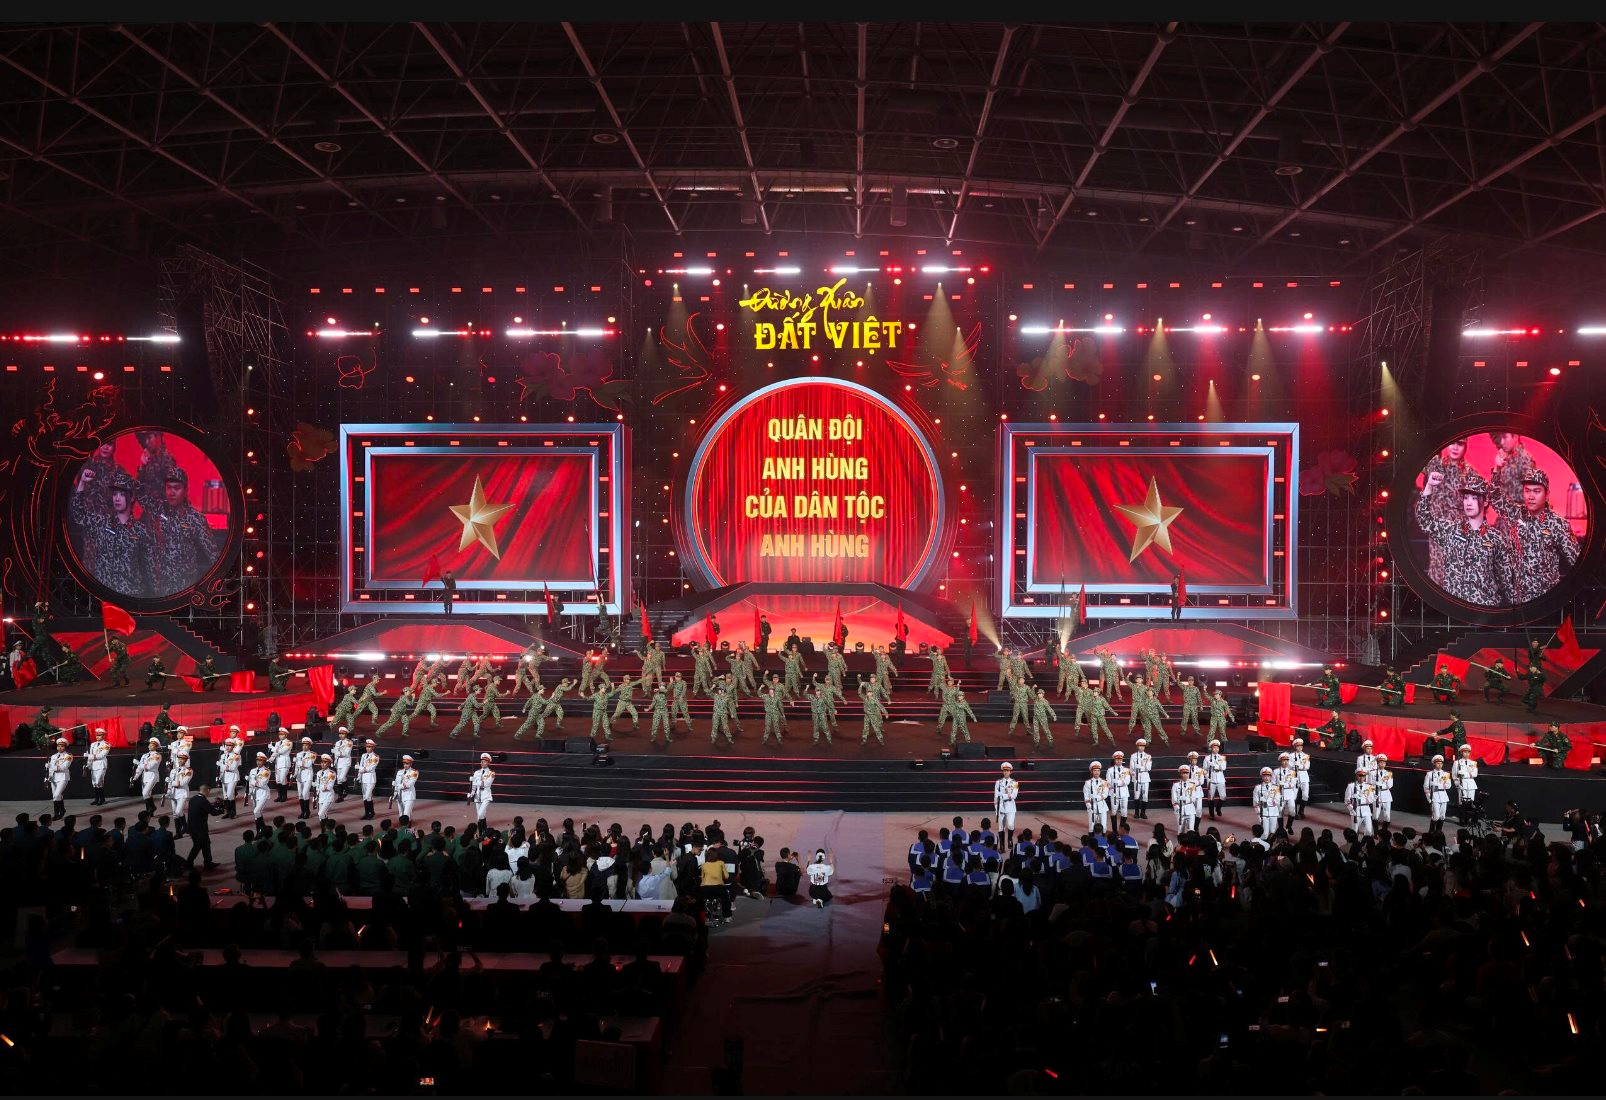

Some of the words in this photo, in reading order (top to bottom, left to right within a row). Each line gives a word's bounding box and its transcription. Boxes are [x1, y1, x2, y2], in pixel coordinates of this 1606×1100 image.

[816, 277, 865, 340] Xuân
[754, 311, 817, 350] ĐẤT
[827, 315, 902, 355] VIỆT
[768, 414, 822, 442] QUÂN
[829, 414, 863, 445] ĐỘI
[762, 457, 806, 480] ANH
[812, 452, 869, 480] HÙNG
[745, 487, 788, 518] CỦA
[794, 491, 838, 518] DÂN
[845, 491, 885, 523] TỘC
[760, 534, 806, 557] ANH
[810, 530, 869, 558] HÙNG
